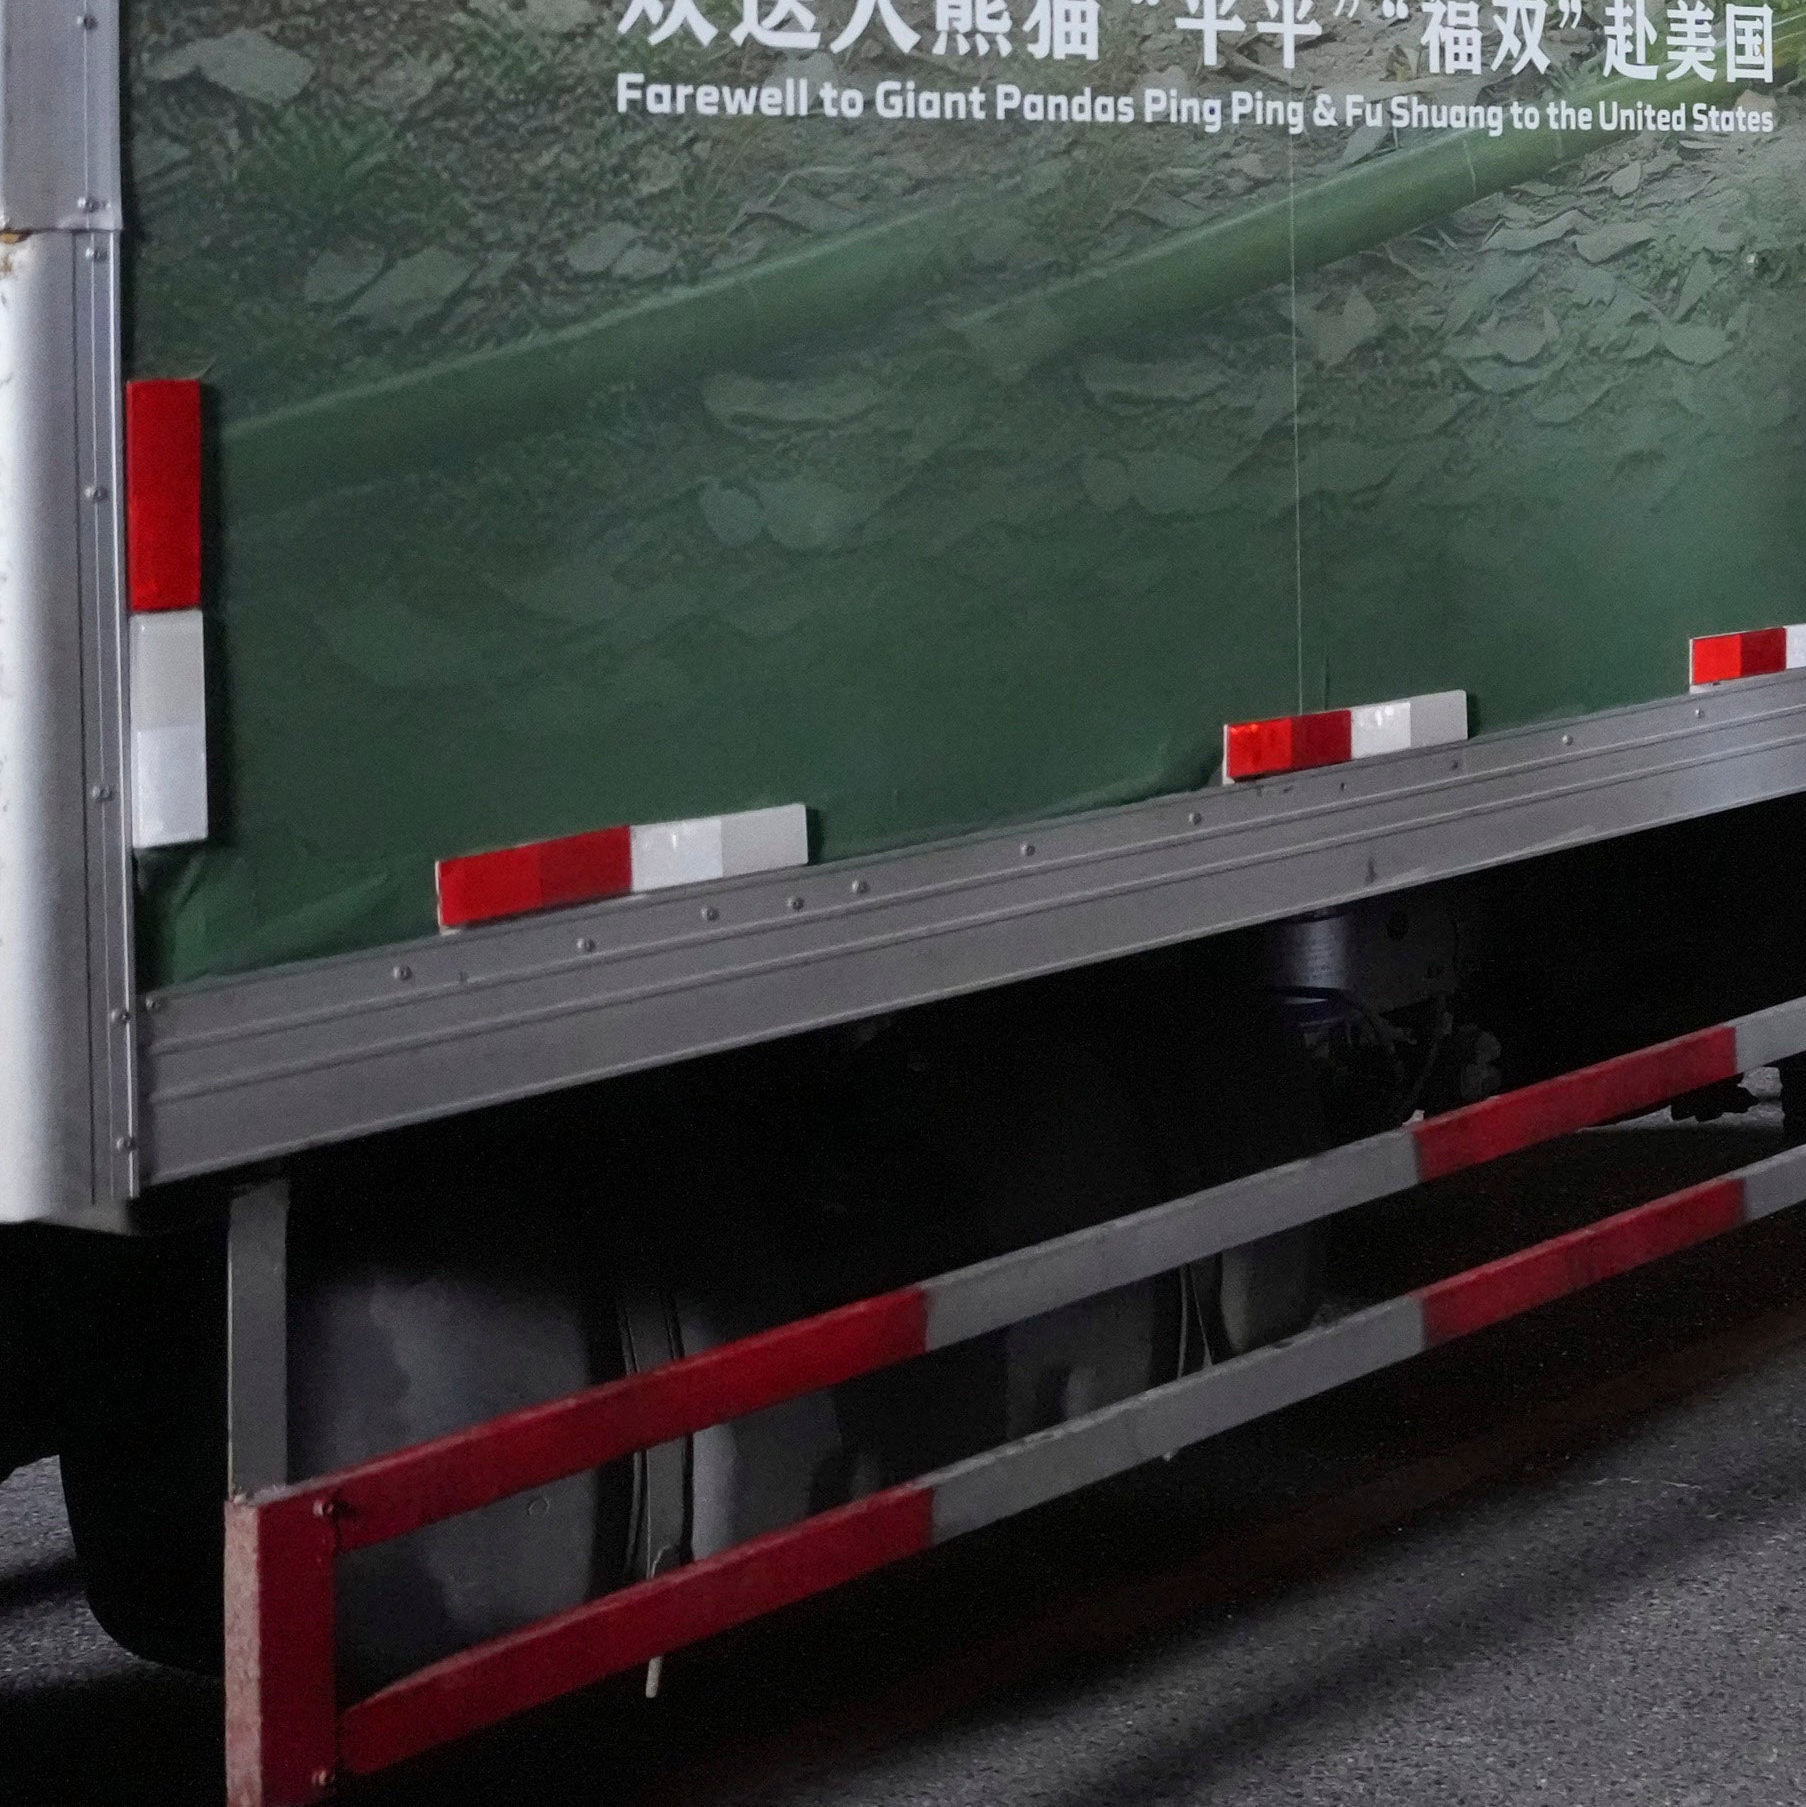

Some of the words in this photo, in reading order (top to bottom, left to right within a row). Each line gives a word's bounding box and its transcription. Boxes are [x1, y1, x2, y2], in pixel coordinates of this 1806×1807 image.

[616, 73, 809, 117] Farewell
[821, 80, 864, 119] to
[875, 80, 985, 120] Giant
[996, 84, 1135, 123] Pandas
[1144, 88, 1222, 133] Ping
[1231, 90, 1302, 135] Ping
[1312, 93, 1338, 127] &
[1346, 93, 1384, 128] Fu
[1392, 96, 1503, 137] Shuang
[1510, 101, 1540, 131] to
[1546, 98, 1593, 131] the
[1600, 100, 1686, 132] United
[1693, 102, 1773, 134] States
